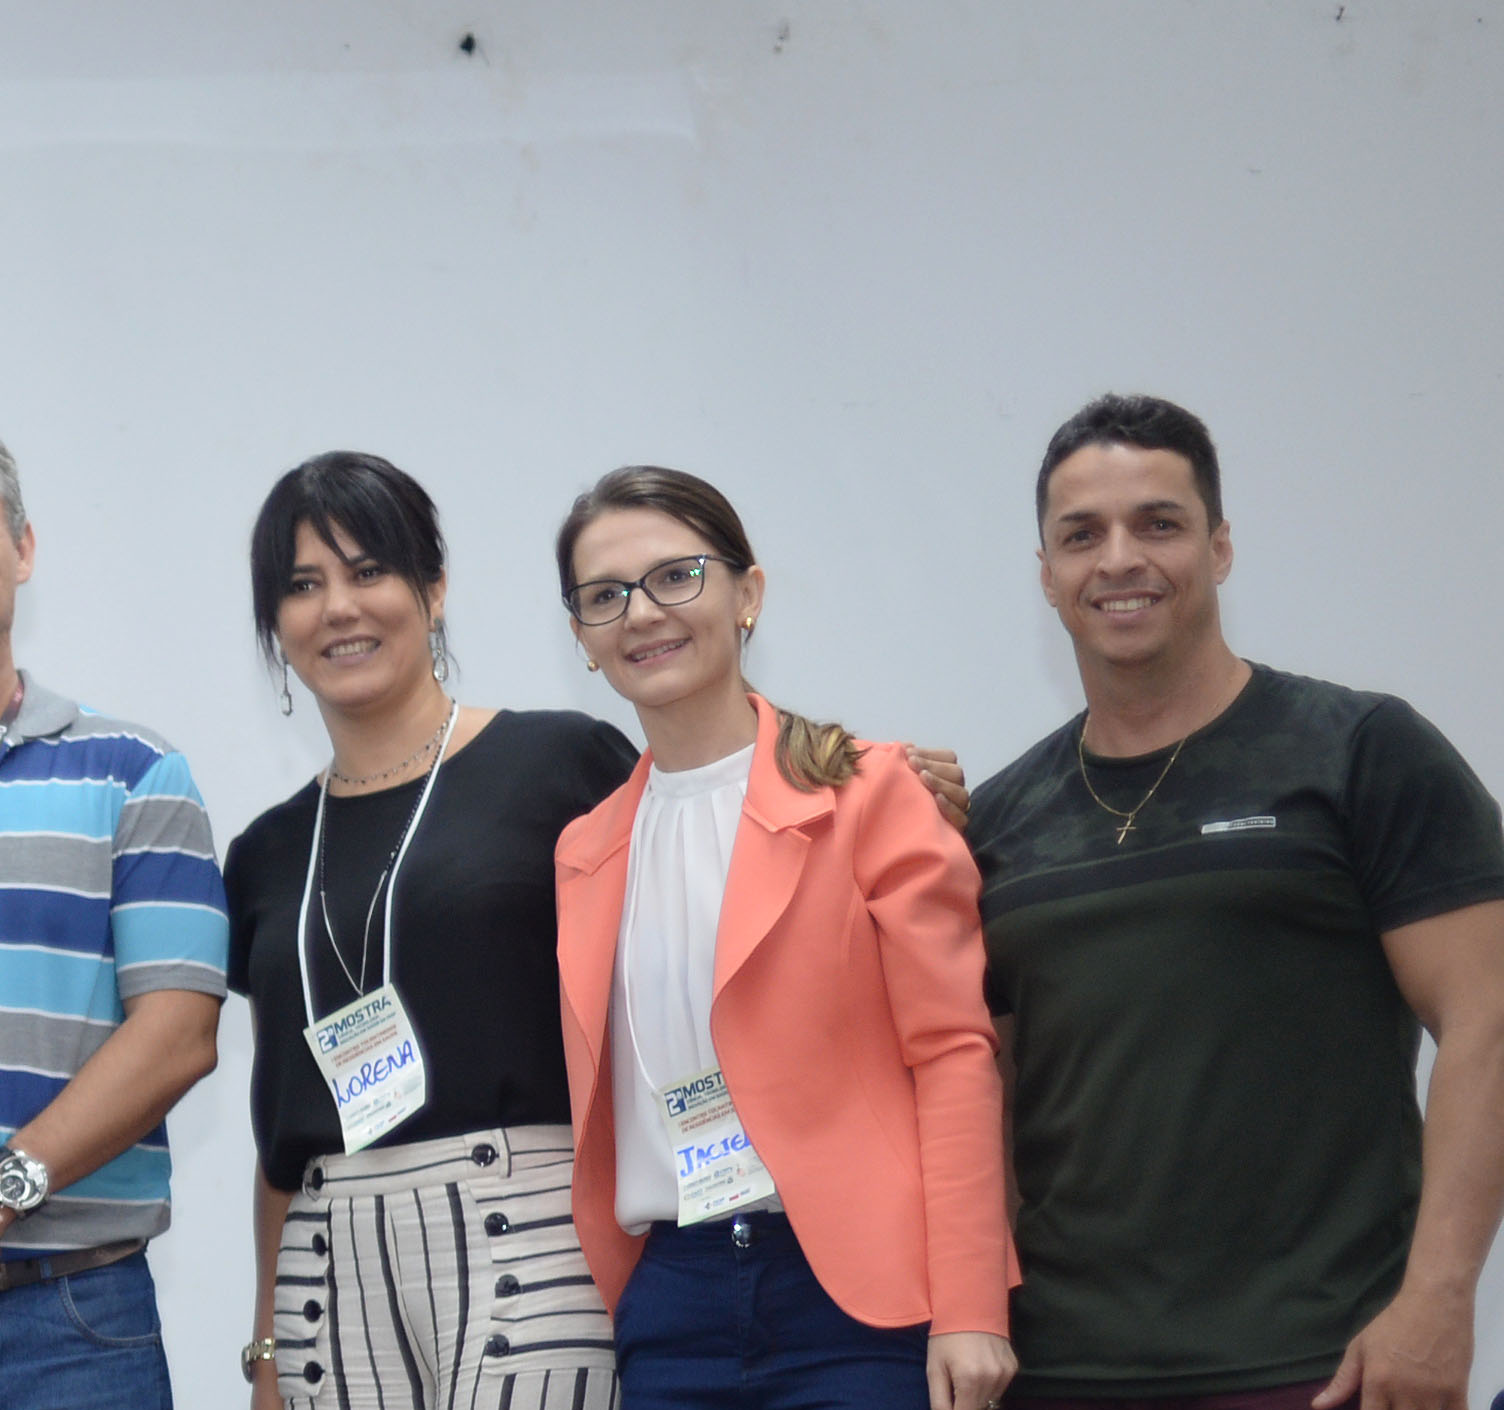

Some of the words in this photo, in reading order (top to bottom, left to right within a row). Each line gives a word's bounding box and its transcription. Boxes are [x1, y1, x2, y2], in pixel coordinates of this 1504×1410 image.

[335, 996, 392, 1034] MOSTRA
[332, 1040, 415, 1108] LORENA
[683, 1071, 723, 1099] MOST
